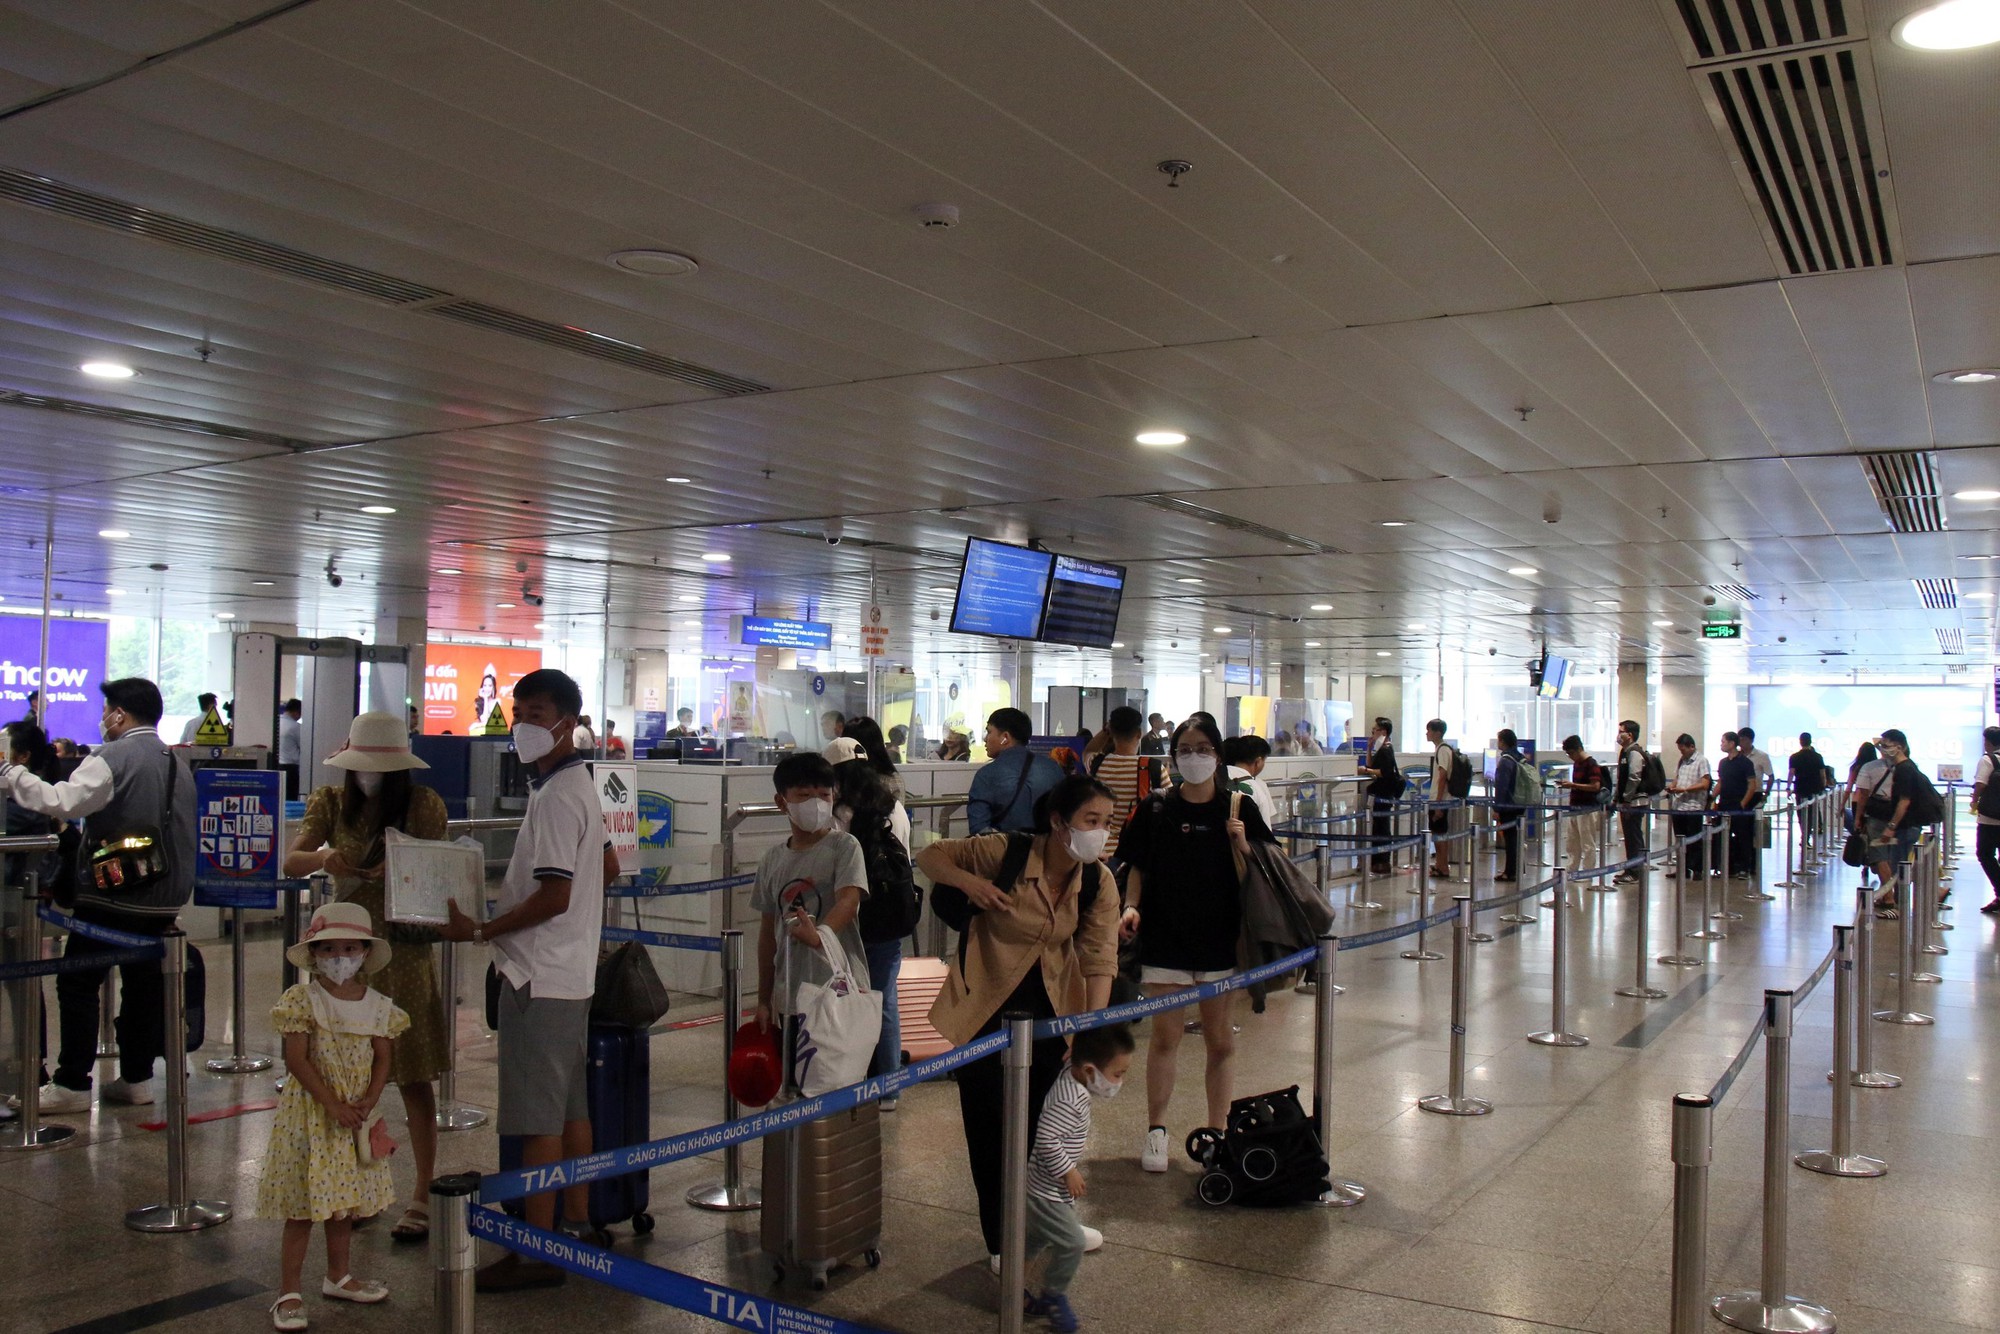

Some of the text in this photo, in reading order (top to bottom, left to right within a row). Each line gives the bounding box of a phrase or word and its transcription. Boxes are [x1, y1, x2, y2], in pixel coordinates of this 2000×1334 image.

[817, 680, 821, 690] 5
[642, 887, 660, 895] TIA
[656, 934, 679, 945] TIA
[1213, 980, 1230, 994] TIA
[1048, 1018, 1076, 1034] TIA
[917, 1033, 1008, 1077] TAN SON NHAT INTERNATIONAL
[854, 1081, 881, 1102] TIA
[627, 1097, 824, 1165] CẢNG HÀNG KHÔNG QUỐC TẾ TÂN SƠN NHẤT
[520, 1165, 566, 1192] TIA
[497, 1220, 513, 1240] TẾ
[516, 1228, 541, 1250] TÂN
[545, 1240, 573, 1262] SƠN
[577, 1250, 614, 1275] NHẤT
[704, 1288, 764, 1329] TIA
[778, 1307, 835, 1328] TAN SON NHAT
[777, 1318, 837, 1334] INTERNATION
